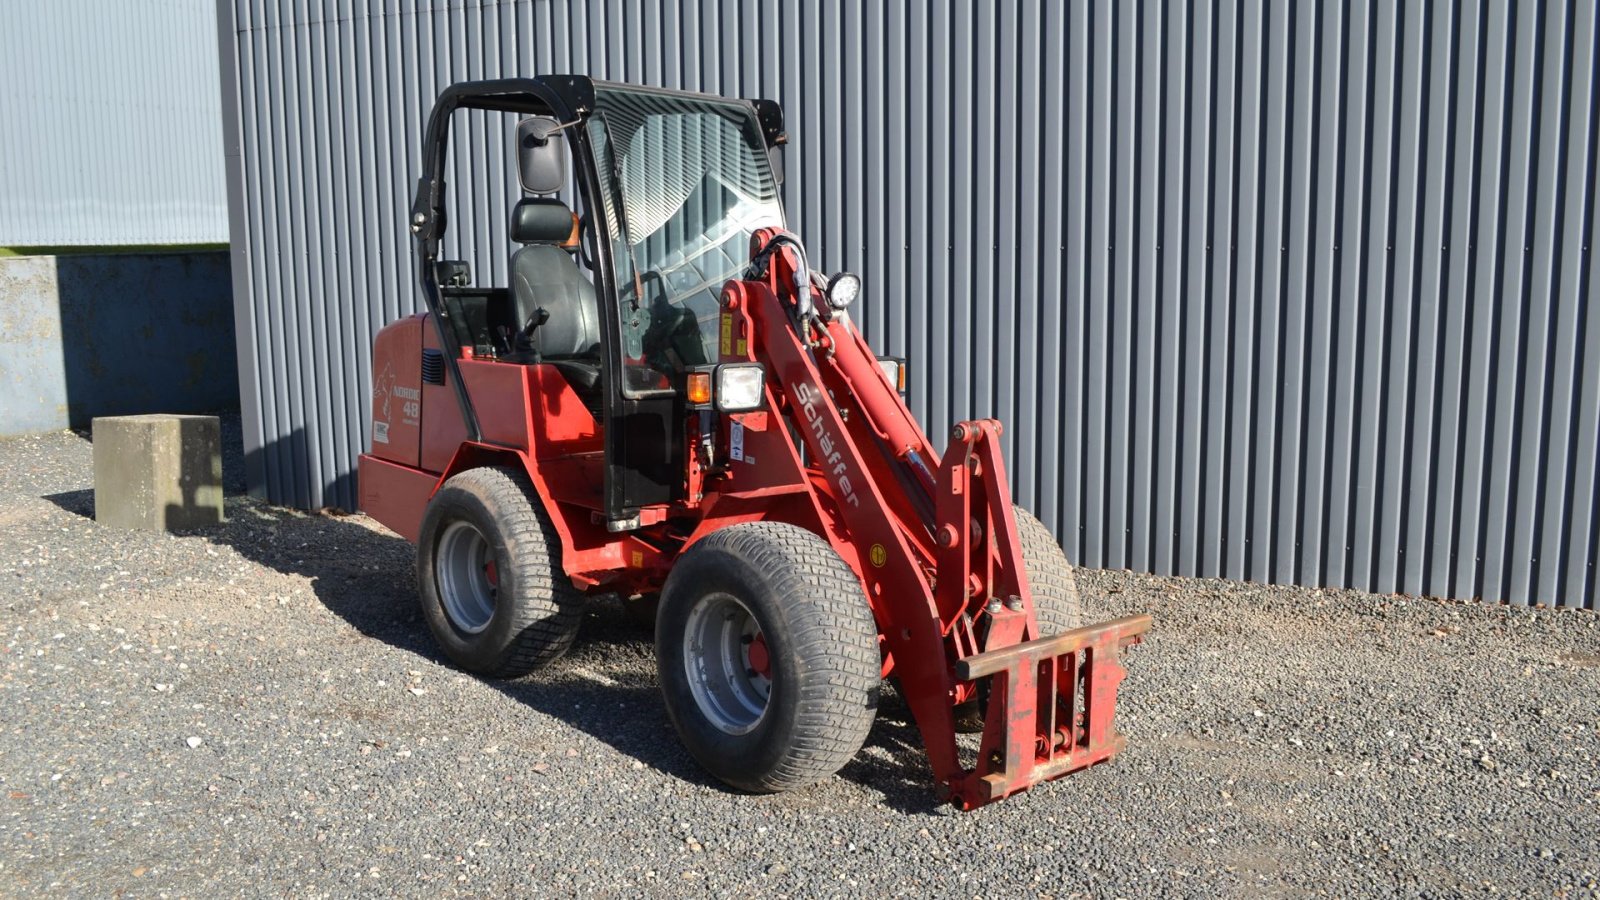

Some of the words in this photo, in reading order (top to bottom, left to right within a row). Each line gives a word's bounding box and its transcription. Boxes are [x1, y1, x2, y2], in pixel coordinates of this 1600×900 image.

[393, 386, 420, 400] NORDIC
[403, 402, 419, 418] 48
[791, 382, 859, 507] Schäffer
